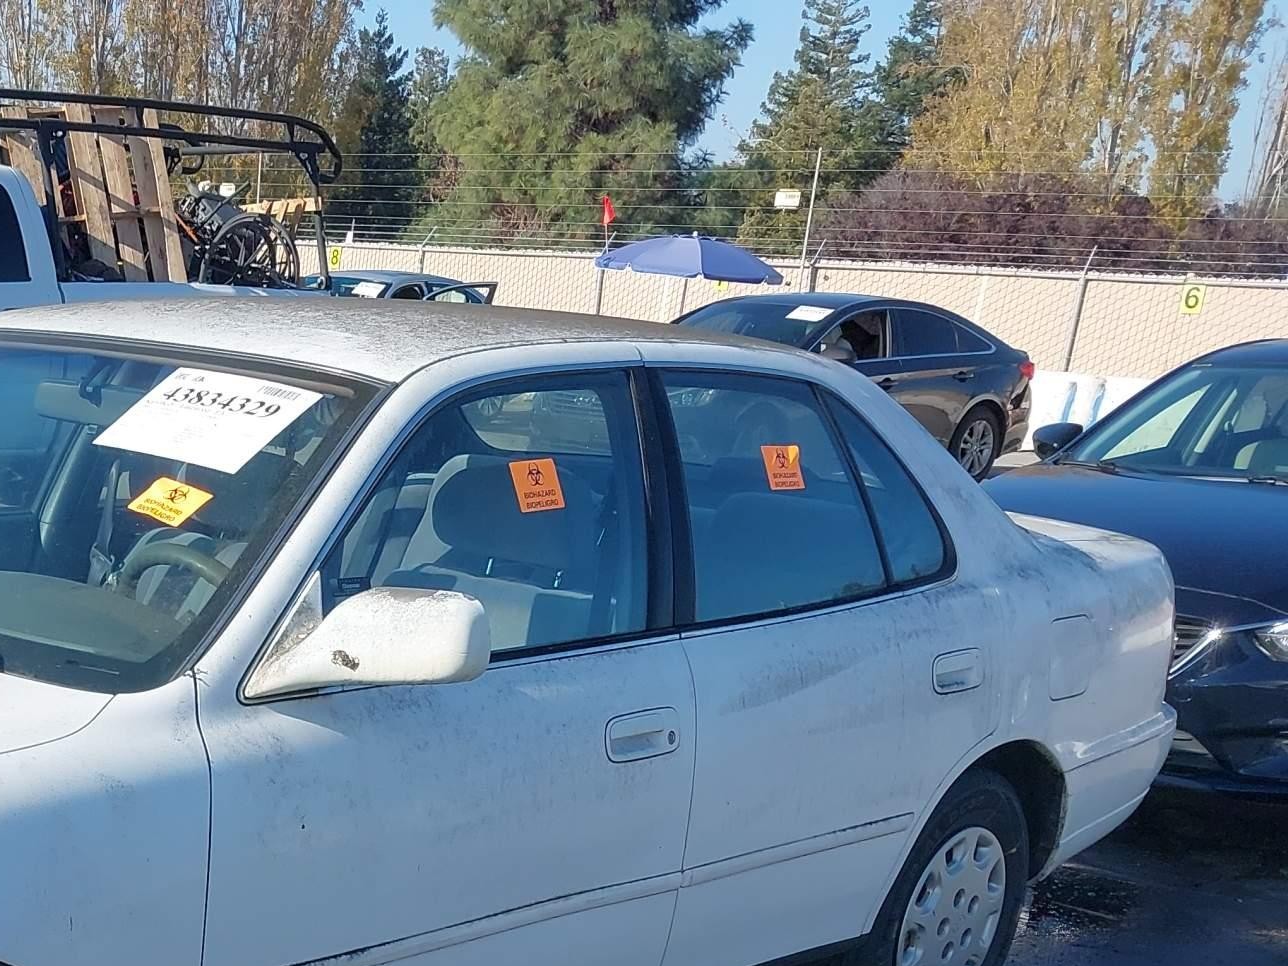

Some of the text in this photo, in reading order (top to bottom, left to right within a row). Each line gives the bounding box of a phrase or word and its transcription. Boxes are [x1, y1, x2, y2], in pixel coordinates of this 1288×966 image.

[330, 249, 340, 266] 8
[1185, 286, 1200, 309] 6
[163, 386, 281, 418] 43834329
[524, 489, 556, 499] BIOHAZARD
[527, 499, 559, 509] BIOPELIGRO
